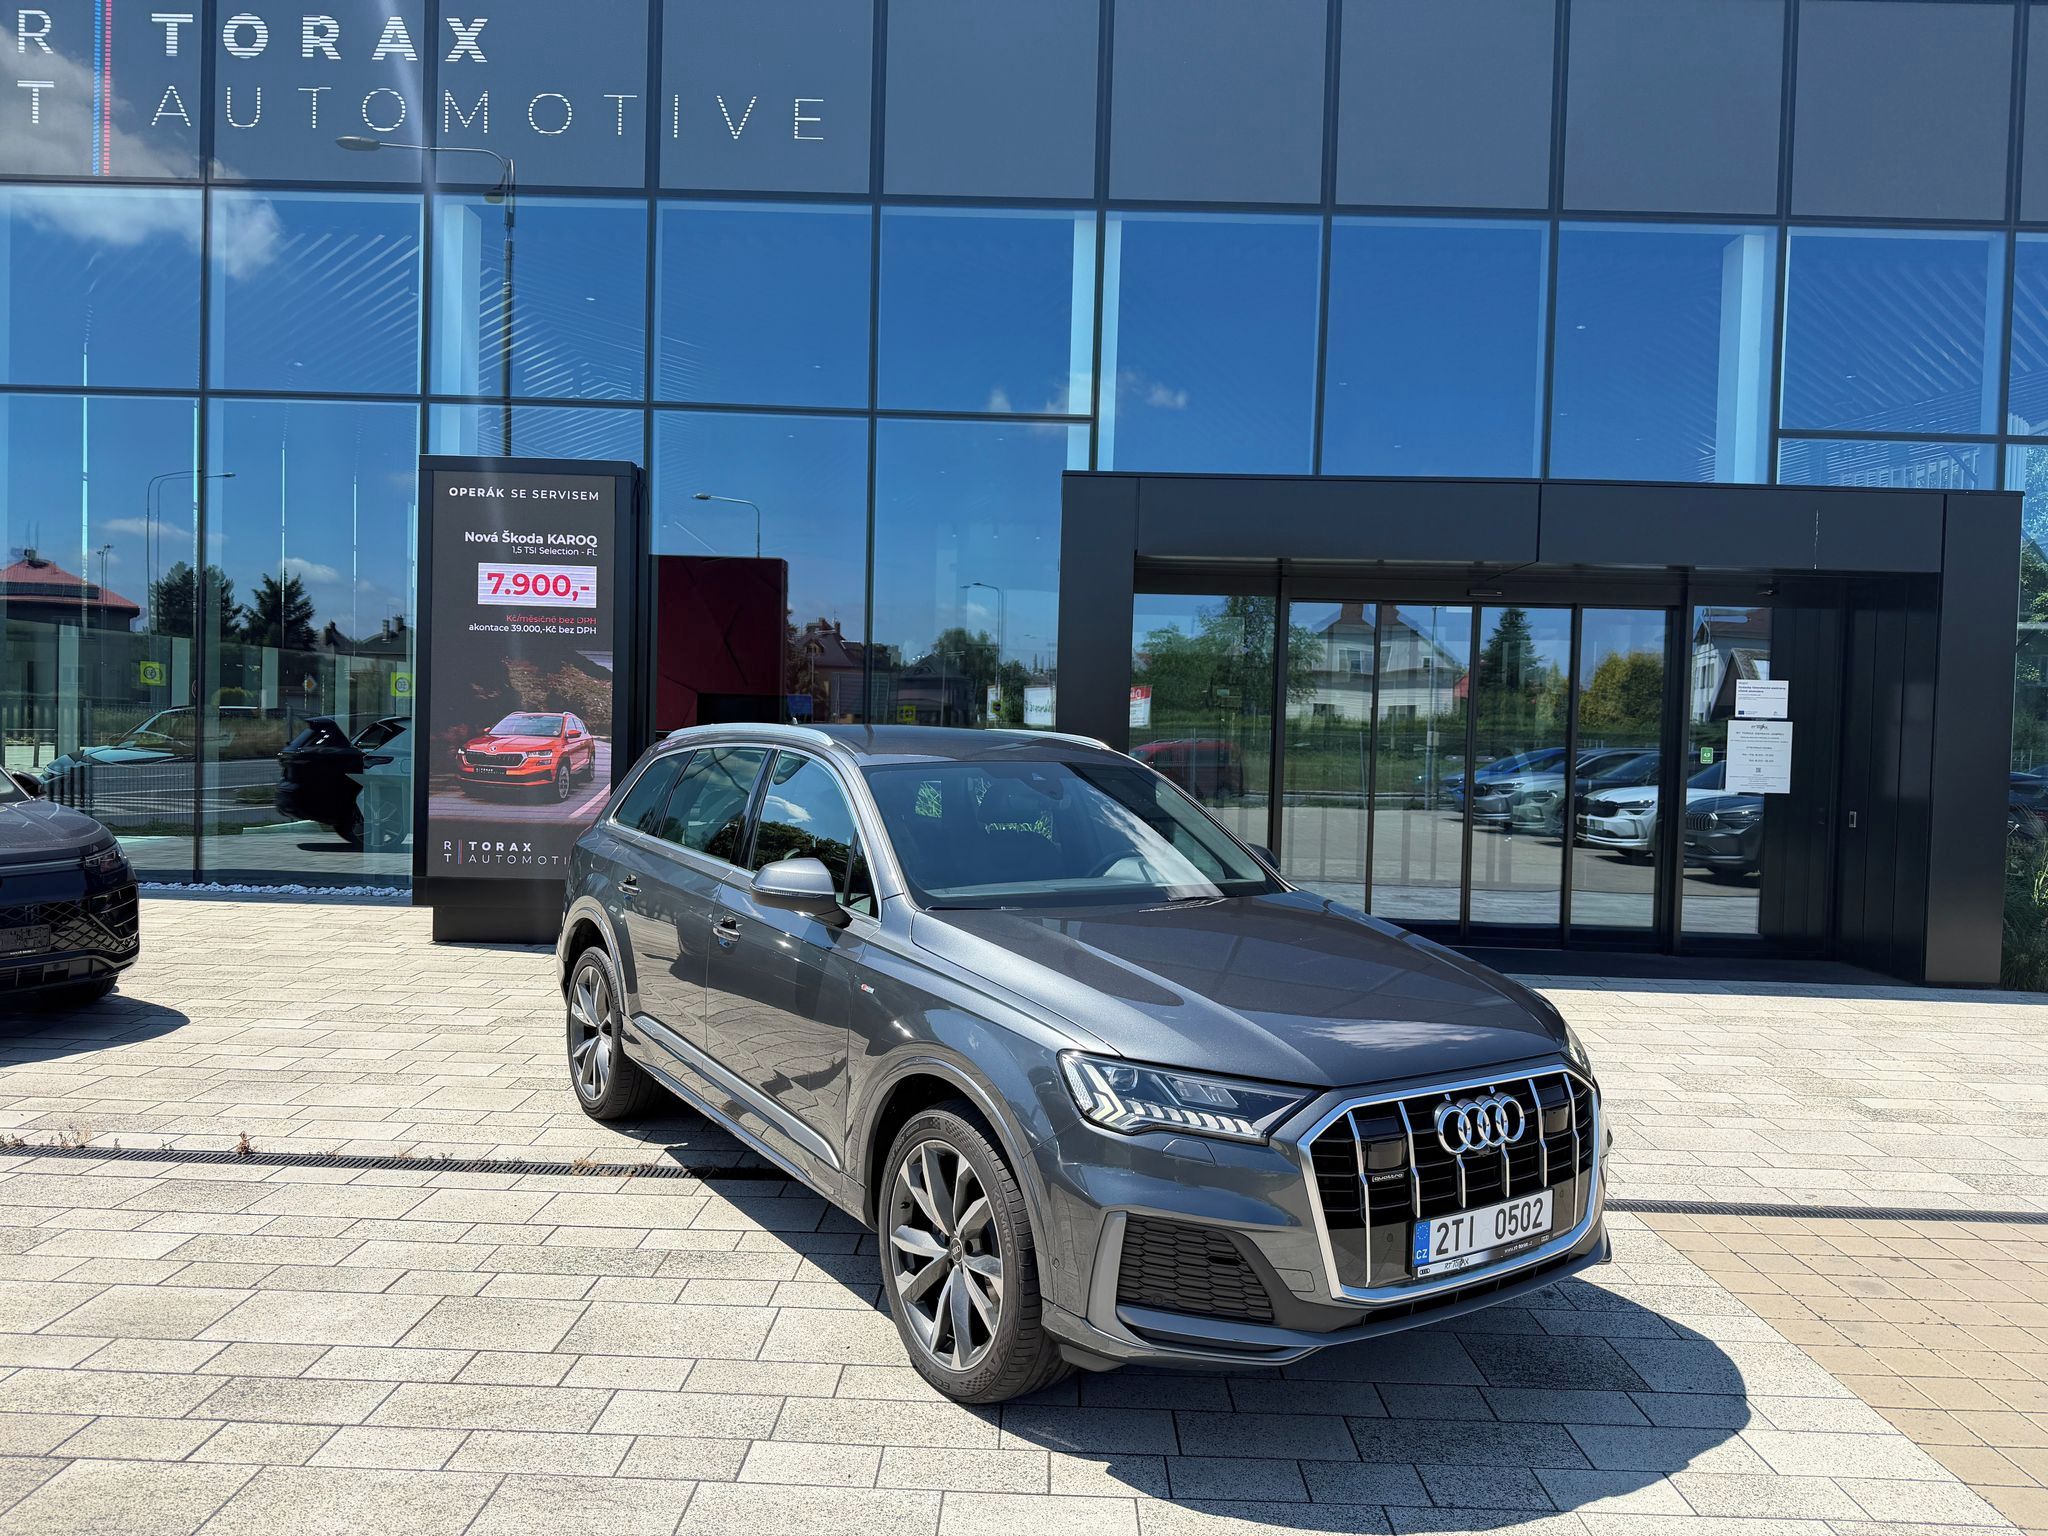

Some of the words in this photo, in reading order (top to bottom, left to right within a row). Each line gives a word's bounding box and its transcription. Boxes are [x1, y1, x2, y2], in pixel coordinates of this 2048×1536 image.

[18, 9, 53, 54] R
[151, 13, 489, 63] TORAX
[17, 80, 54, 124] T
[151, 85, 825, 141] AUTOMOTIVE
[449, 486, 505, 498] OPERÁK
[510, 489, 527, 498] SE
[532, 489, 599, 501] SERVISEM
[464, 531, 499, 543] Nová
[501, 530, 544, 544] Škoda
[547, 534, 598, 548] KAROQ
[524, 546, 537, 554] TSI
[539, 546, 579, 556] Selection
[586, 548, 598, 556] FL
[487, 572, 590, 602] 7.900,-
[577, 617, 597, 625] DPH
[469, 623, 510, 632] akontace
[558, 626, 575, 634] bez
[577, 626, 597, 635] DPH
[443, 840, 452, 850] R
[468, 841, 532, 852] TORAX
[444, 853, 452, 863] T
[468, 854, 571, 865] AUTOMOTI
[1435, 1215, 1475, 1256] 2TI
[1494, 1197, 1544, 1240] 0502
[1416, 1248, 1428, 1259] CZ
